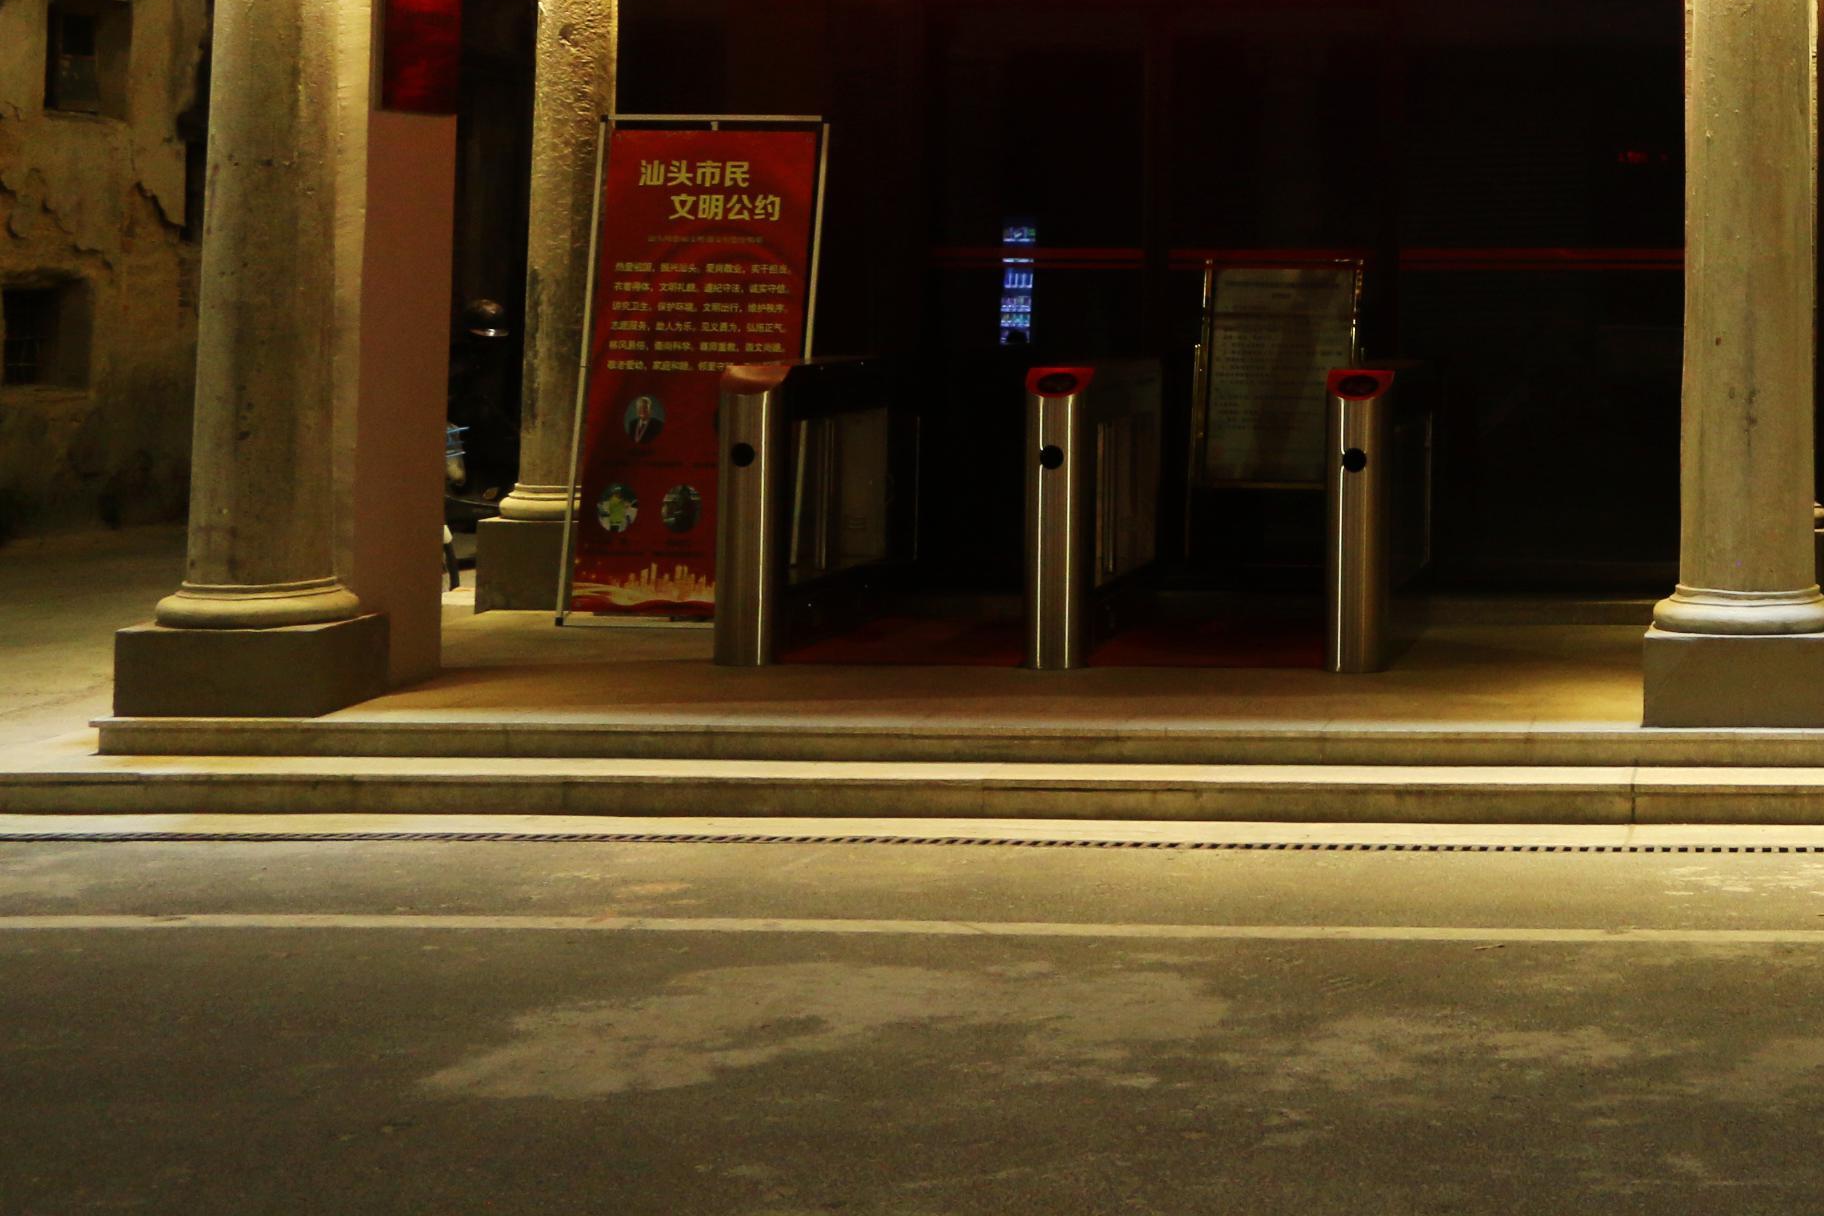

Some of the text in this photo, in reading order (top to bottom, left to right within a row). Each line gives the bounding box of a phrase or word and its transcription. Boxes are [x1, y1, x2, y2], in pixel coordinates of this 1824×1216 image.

[638, 159, 751, 188] 汕头市民
[668, 193, 782, 222] 文明公约
